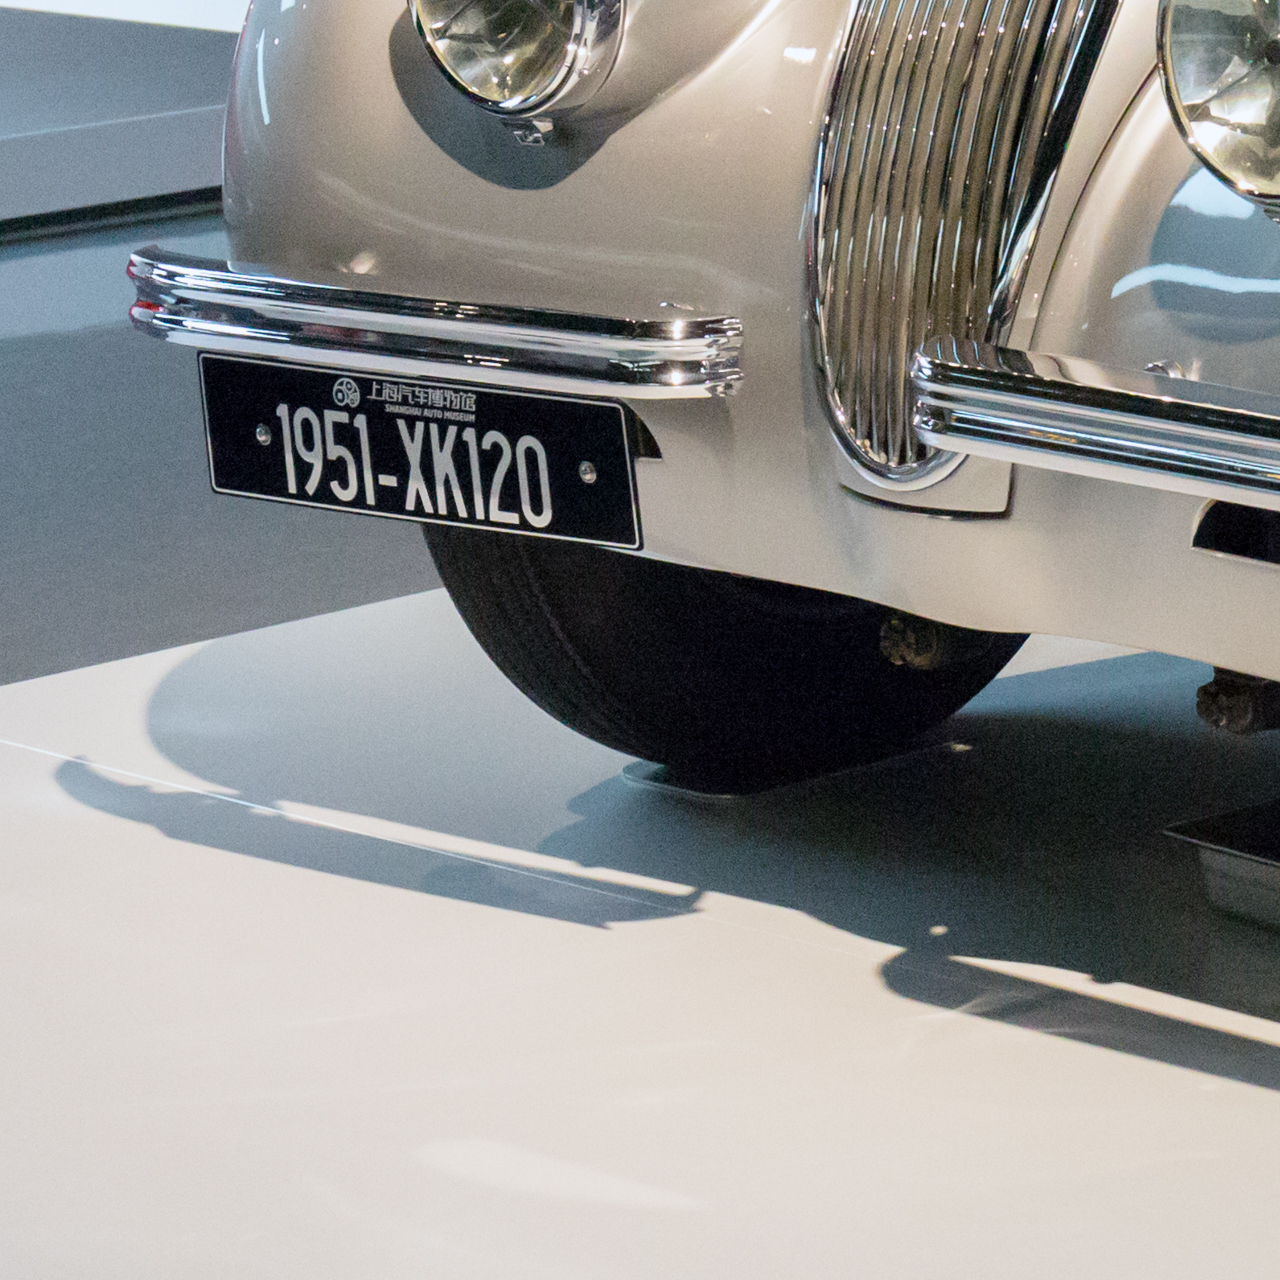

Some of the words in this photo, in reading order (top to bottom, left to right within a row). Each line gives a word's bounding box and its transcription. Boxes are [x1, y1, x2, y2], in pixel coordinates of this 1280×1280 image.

[366, 381, 476, 411] 上海汽车博物馆
[385, 403, 422, 416] SHANGHAI
[423, 407, 443, 419] AUTO
[444, 411, 476, 422] MUSEUM
[276, 403, 553, 529] 1951-XK120
